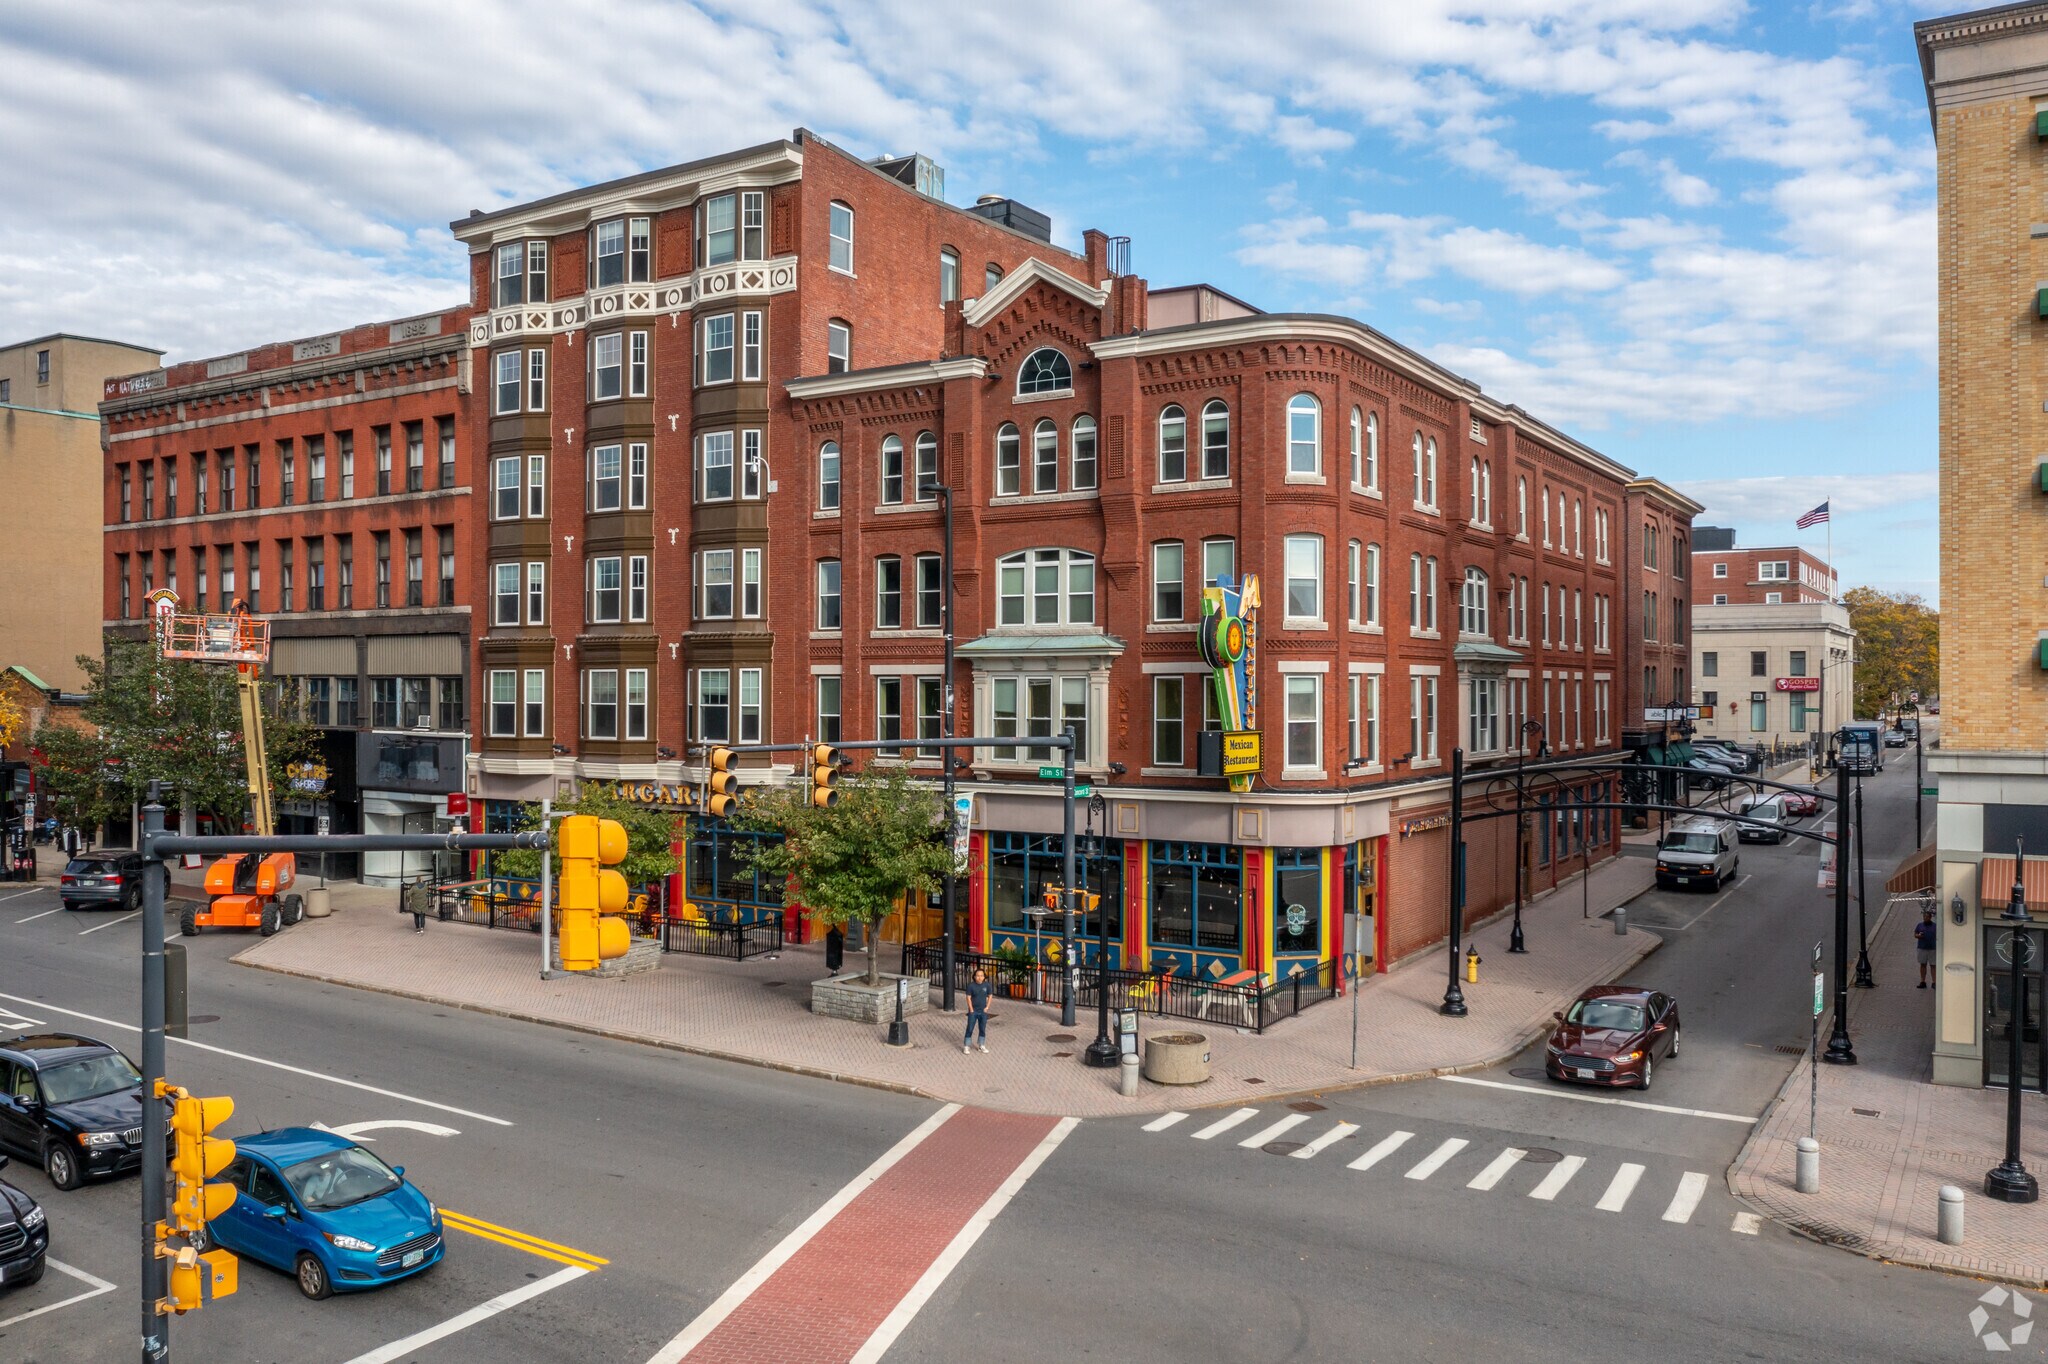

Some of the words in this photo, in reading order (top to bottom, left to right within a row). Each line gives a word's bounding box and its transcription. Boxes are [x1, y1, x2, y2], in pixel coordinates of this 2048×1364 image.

[402, 322, 427, 339] 1892
[301, 341, 332, 358] FITTS
[1230, 739, 1253, 750] Mexican
[1225, 755, 1258, 766] Restaurant
[1040, 768, 1053, 776] Elm
[1055, 768, 1063, 777] St
